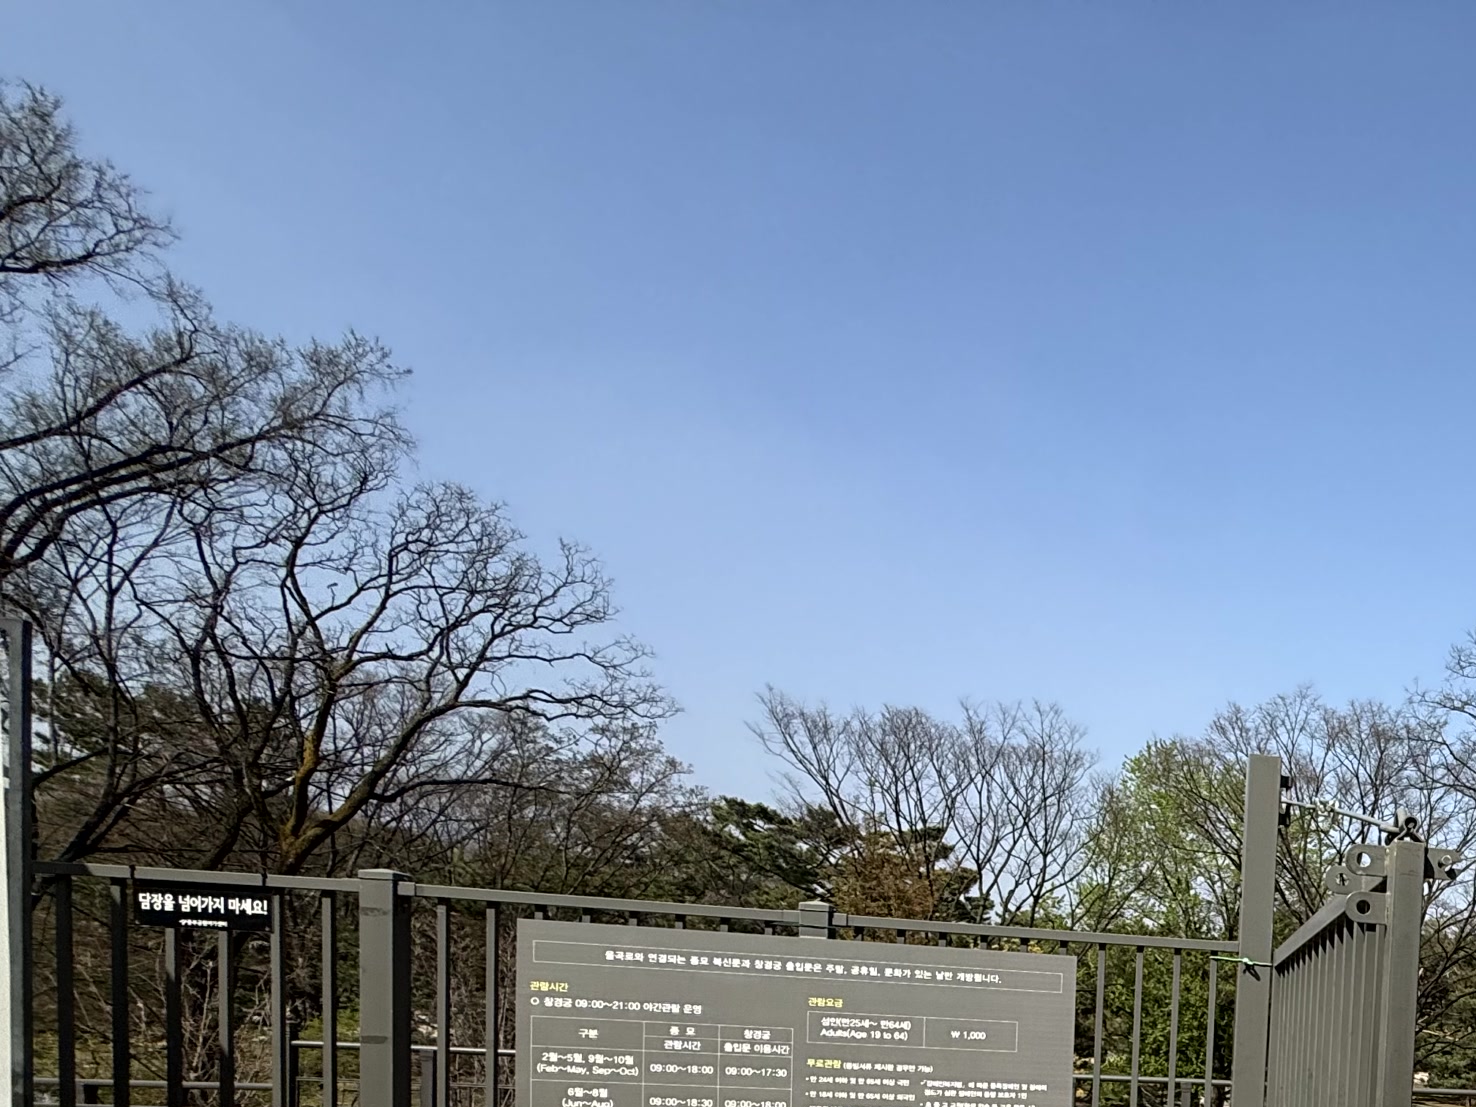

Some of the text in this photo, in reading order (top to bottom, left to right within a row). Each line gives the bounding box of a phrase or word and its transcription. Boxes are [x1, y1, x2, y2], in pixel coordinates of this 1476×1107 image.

[138, 892, 268, 916] 담장을 넘어가지 마세요!
[530, 981, 569, 992] 관람시간
[544, 997, 702, 1015] 창경궁 09:00~21:00 야간관람 운영
[808, 997, 844, 1008] 관람요금
[578, 1029, 599, 1039] 구분
[744, 1029, 771, 1040] 창경궁
[820, 1028, 908, 1041] Adults(Age 19 to 64)
[963, 1031, 986, 1040] 1,000
[664, 1040, 702, 1051] 관람시간
[542, 1052, 634, 1064] 2월~5월, 9월~10월
[650, 1064, 714, 1075] 09:00~18:00
[806, 1059, 842, 1069] 무료관람
[725, 1067, 788, 1078] 09:00~17:30
[568, 1087, 608, 1098] 6월~8월
[650, 1097, 714, 1107] 09:00~18:30
